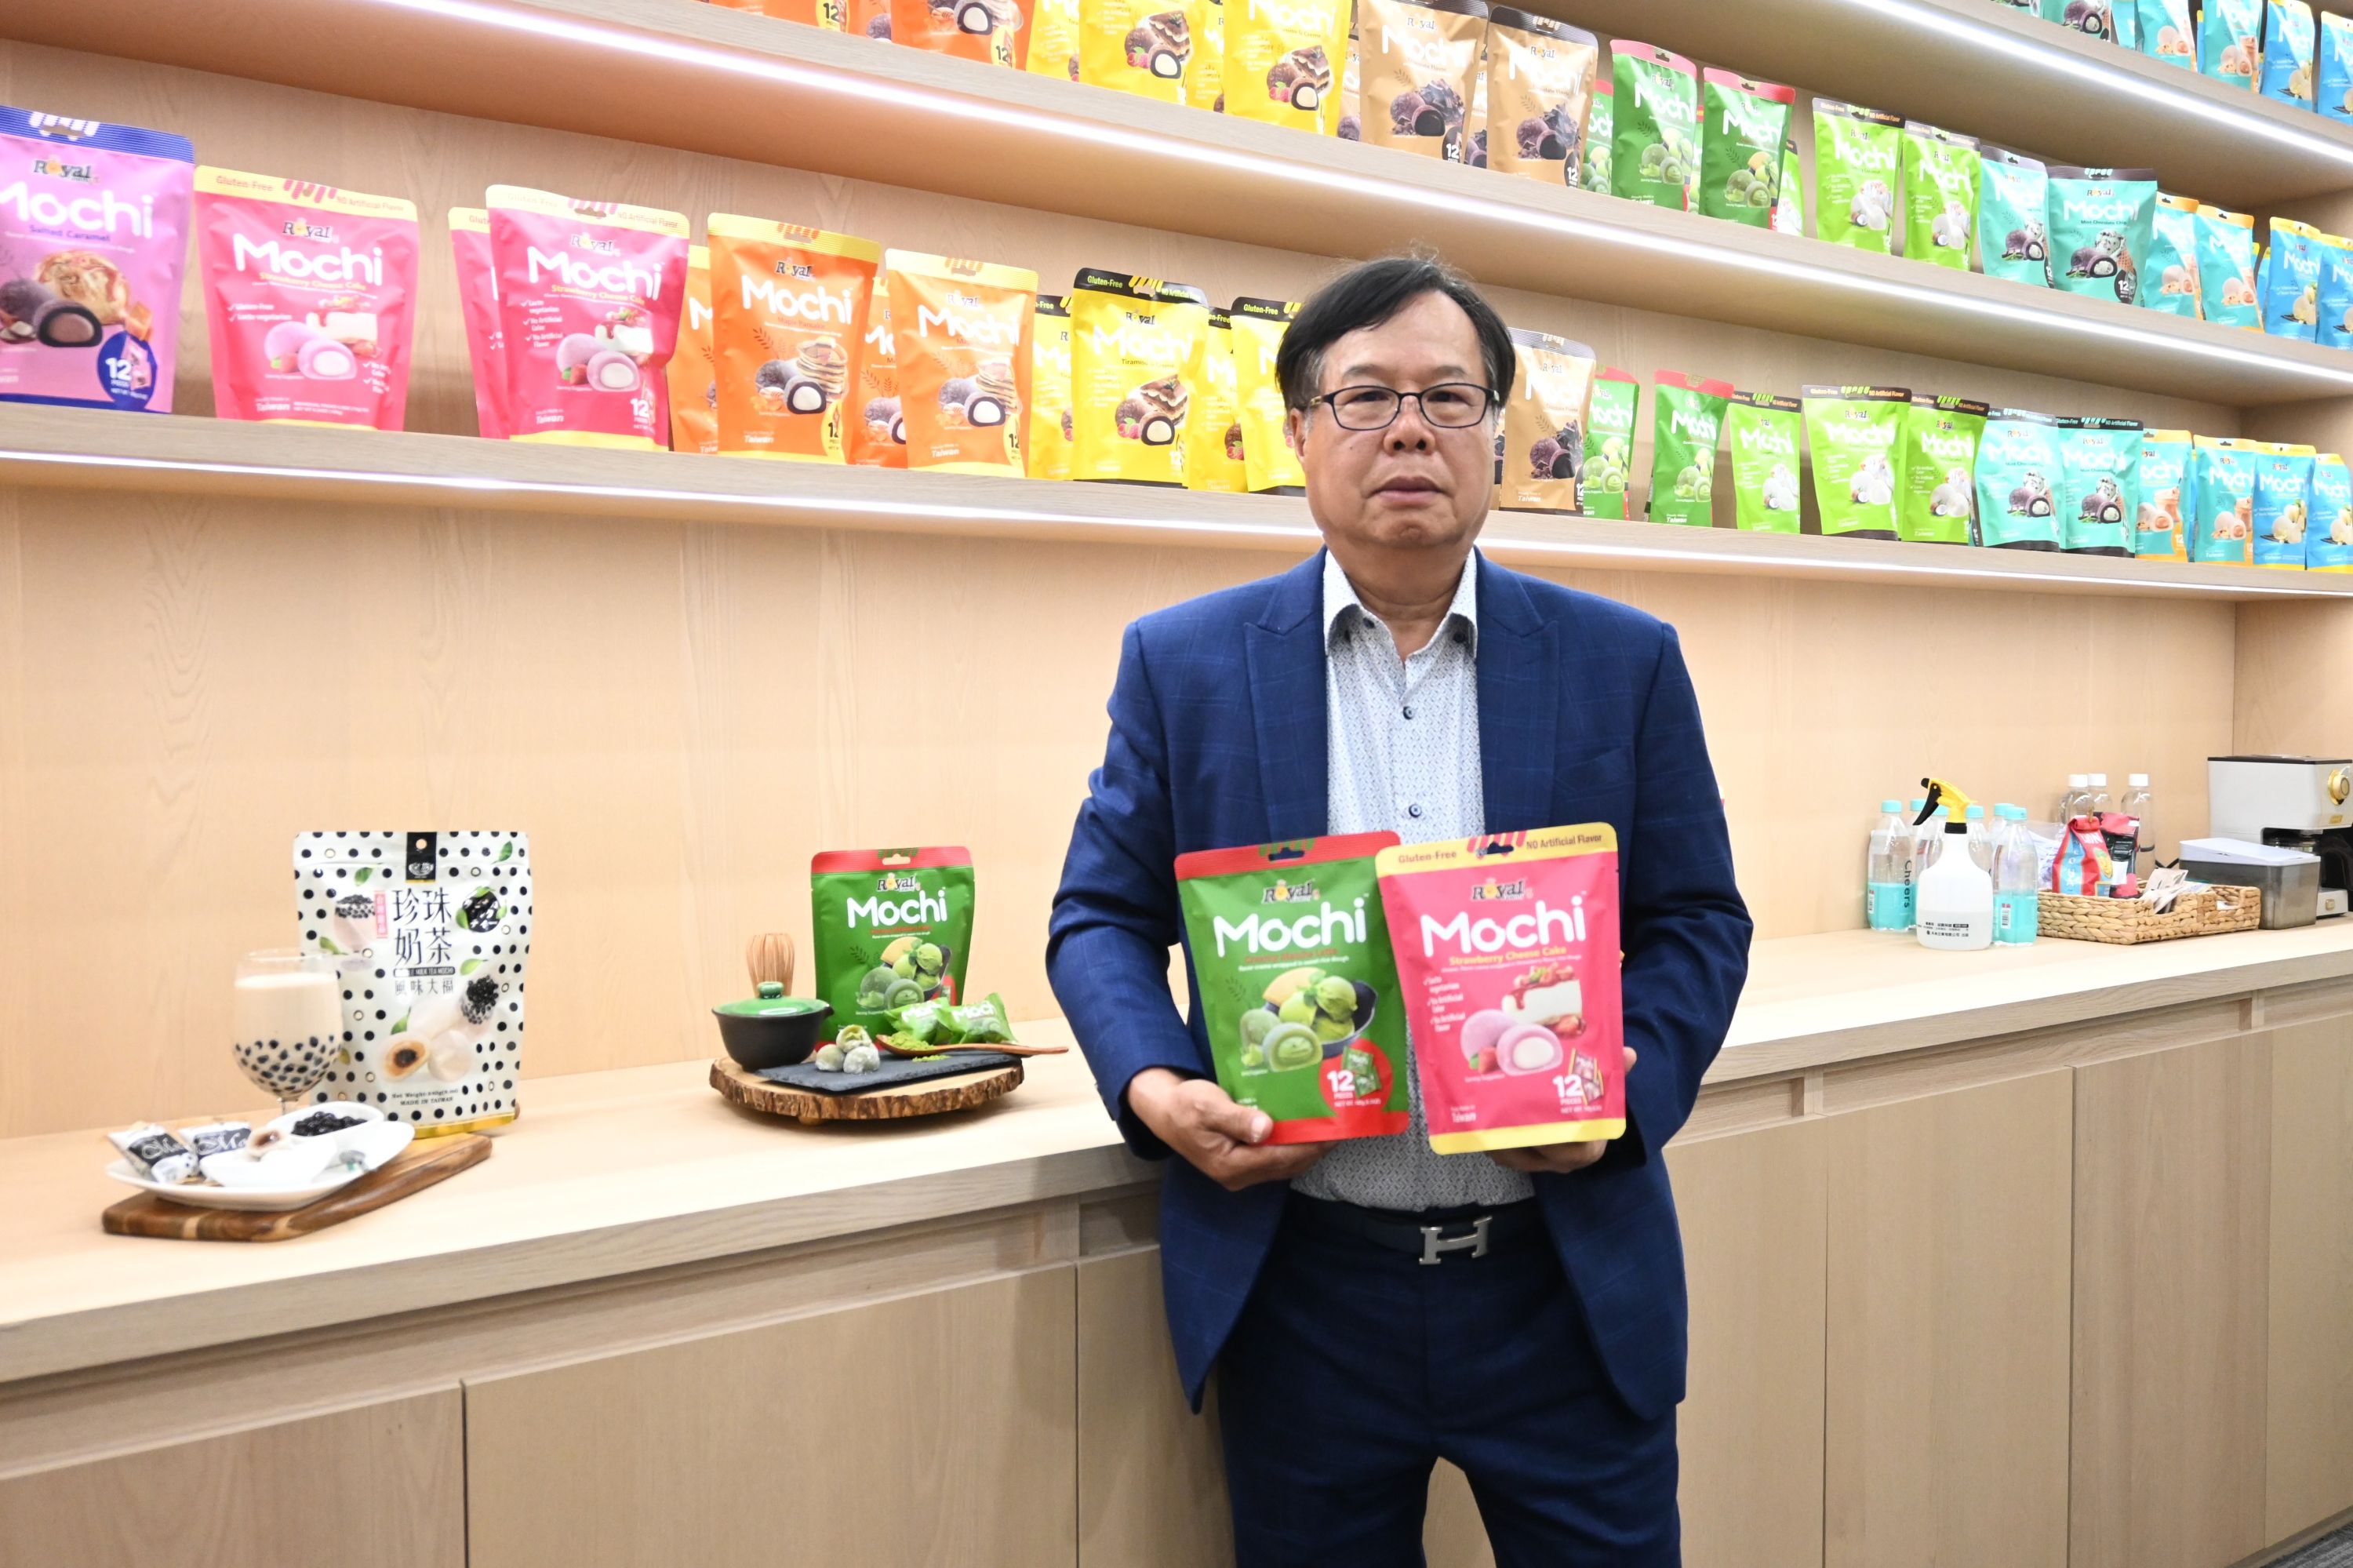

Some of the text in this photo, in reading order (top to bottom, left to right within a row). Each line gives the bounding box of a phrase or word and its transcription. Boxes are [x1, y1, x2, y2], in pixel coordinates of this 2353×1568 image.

[825, 2, 839, 20] 12
[1407, 17, 1435, 31] Royal
[1530, 45, 1555, 58] Royal
[1446, 144, 1460, 158] 12
[1834, 136, 1895, 169] Mochi
[34, 158, 92, 179] Royal
[1567, 166, 1577, 180] 12
[216, 175, 273, 191] Gluten-Free
[2063, 199, 2139, 222] Mochi
[282, 222, 330, 238] Royal
[571, 235, 613, 252] Royal
[233, 233, 383, 286] Mochi
[776, 260, 813, 278] Royal
[527, 246, 662, 301] Mochi
[1087, 275, 1123, 289] Gluten-Free
[551, 284, 597, 299] Strawberry
[598, 291, 628, 302] Cheese
[2118, 280, 2129, 291] 12
[741, 275, 852, 326] Mochi
[1243, 304, 1278, 315] Gluten-Free
[918, 304, 1020, 346] Mochi
[1093, 326, 1193, 365] Mochi
[105, 357, 132, 380] 12
[630, 398, 649, 418] 12
[1824, 420, 1897, 446] Mochi
[1921, 431, 1973, 458] Mochi
[2140, 459, 2184, 481] ochi
[2260, 474, 2308, 493] Mochi
[1398, 834, 1603, 864] Gluten-Free NO Artificial Flavor
[877, 875, 916, 891] Royal
[1263, 881, 1312, 903] Royal
[1471, 880, 1525, 900] Royal
[1904, 860, 1912, 909] Cheers
[392, 887, 452, 926] 珍珠
[847, 890, 947, 928] Mochi
[1213, 897, 1366, 958] Mochi
[1420, 894, 1587, 958] Mochi
[394, 926, 453, 967] 奶茶
[1449, 952, 1504, 966] Strawberry
[1505, 949, 1540, 961] Cheese
[1541, 945, 1567, 956] Cake
[1326, 1070, 1355, 1093] 12
[1553, 1075, 1582, 1098] 12
